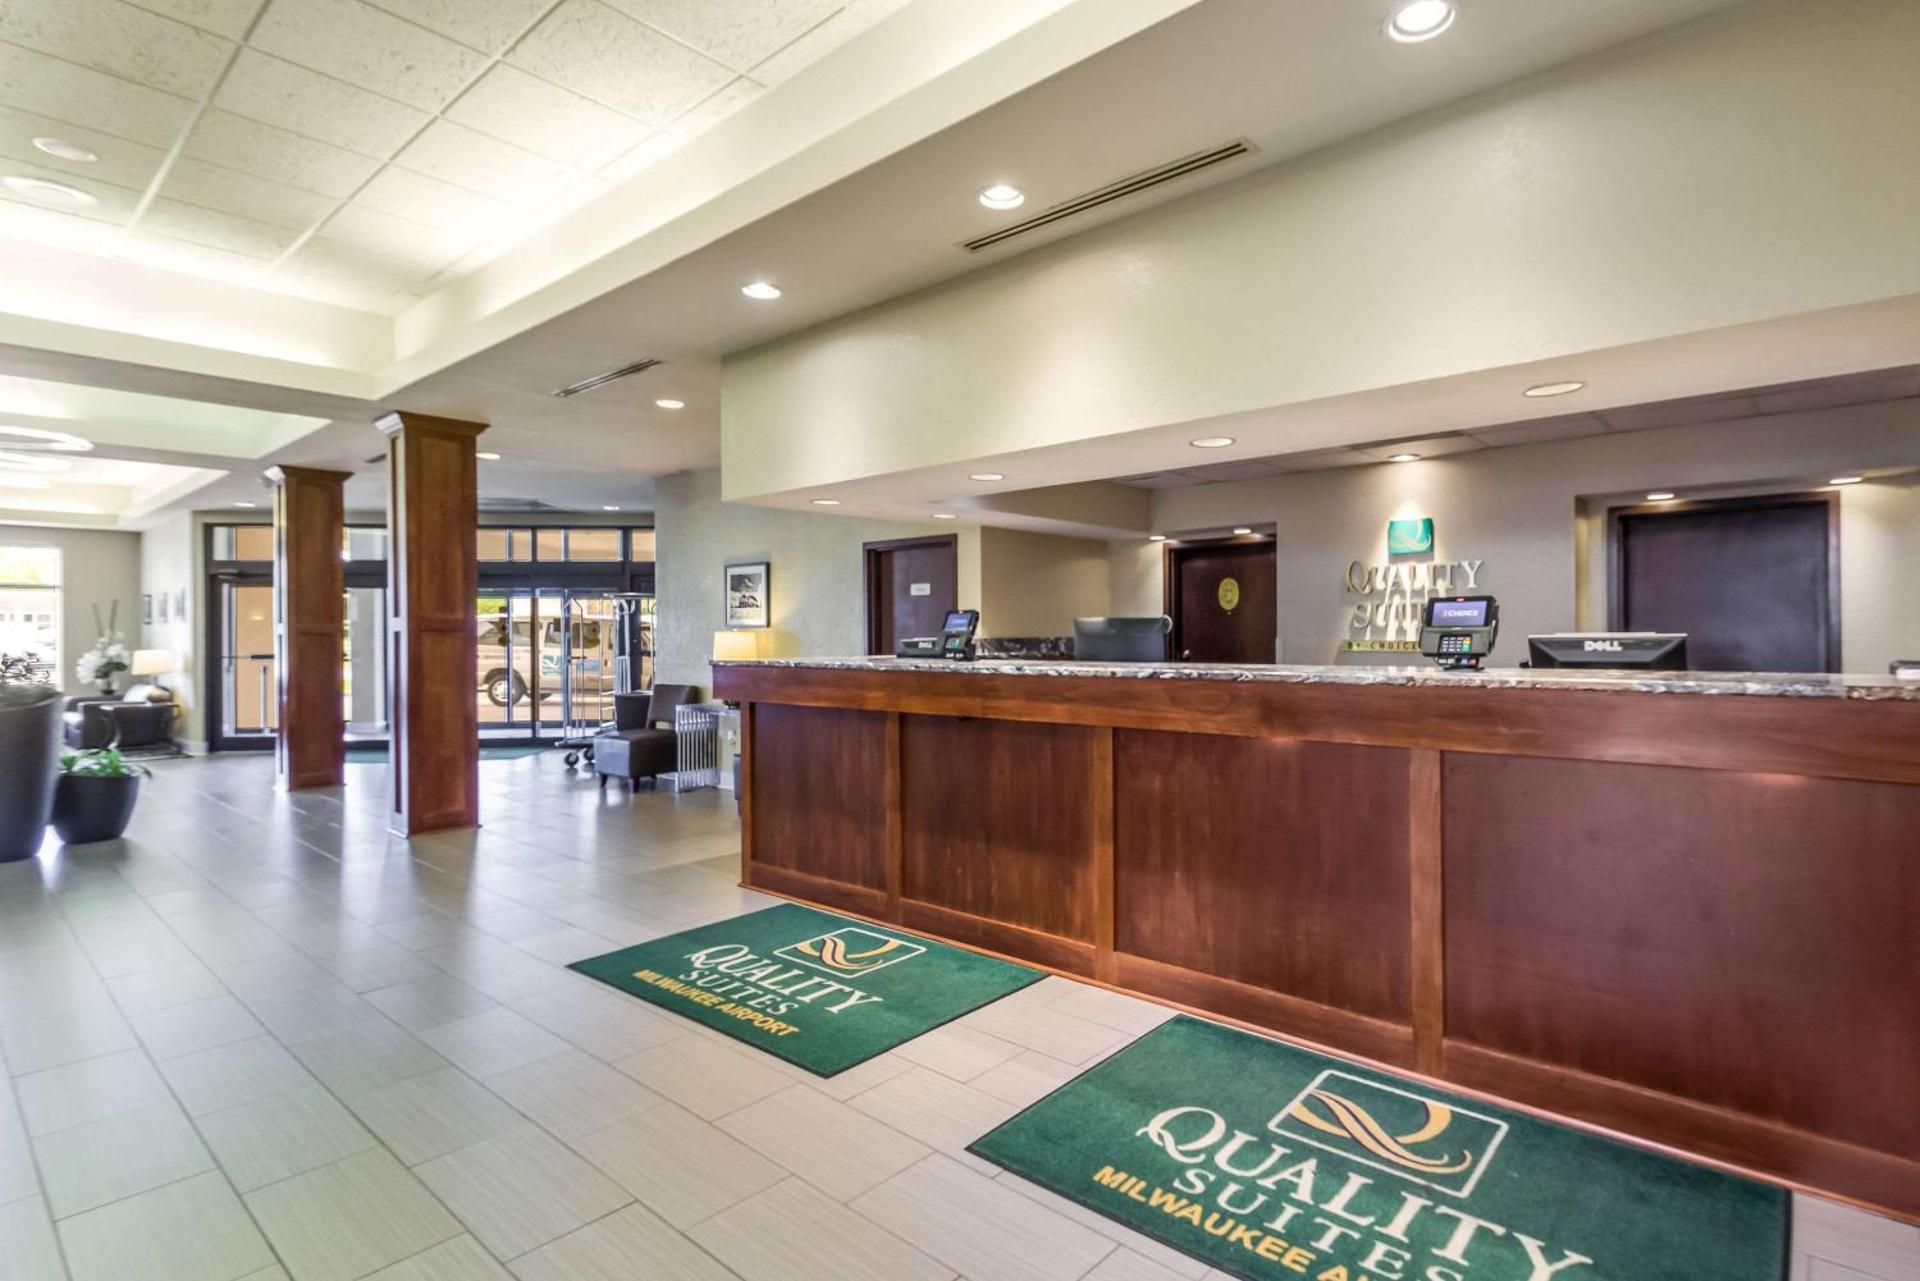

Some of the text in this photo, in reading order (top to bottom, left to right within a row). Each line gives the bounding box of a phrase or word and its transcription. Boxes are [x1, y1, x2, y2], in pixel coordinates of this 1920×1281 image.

[1345, 560, 1482, 594] QUALITY
[1353, 602, 1428, 629] SUIT
[1370, 641, 1417, 650] CHOICE
[1584, 640, 1622, 652] DELL
[679, 969, 799, 1016] SUITES
[683, 943, 884, 1014] QUALITY
[632, 969, 800, 1037] MILWAUKEE AIRPORT
[1135, 1106, 1594, 1281] QUALITY
[1092, 1165, 1317, 1274] MILWAUKEE
